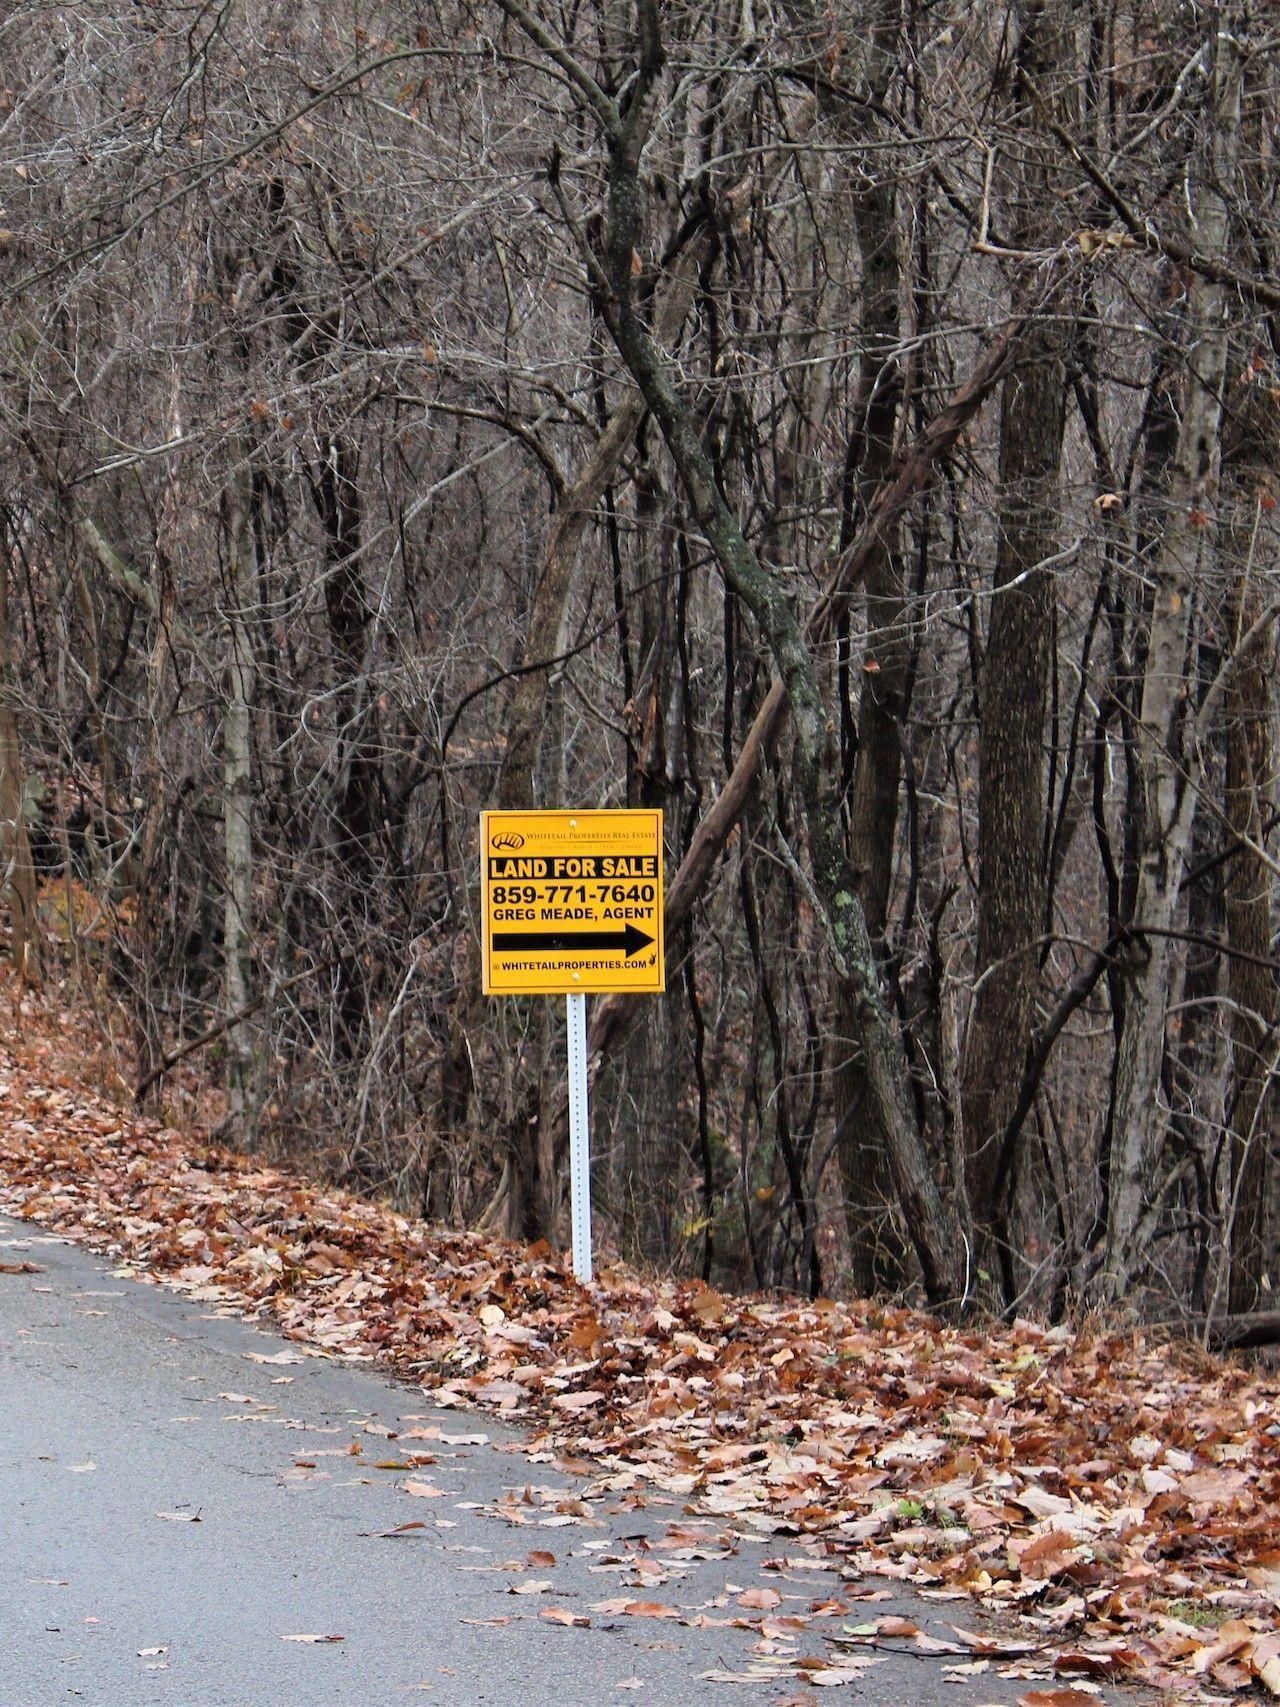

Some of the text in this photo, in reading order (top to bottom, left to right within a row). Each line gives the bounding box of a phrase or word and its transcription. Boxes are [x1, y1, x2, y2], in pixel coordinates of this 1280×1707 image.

[491, 857, 655, 878] LAND FOR SALE
[493, 885, 655, 904] 859-771-7640
[493, 907, 654, 921] GREG MEADE, AGENT
[502, 960, 647, 970] WHITETAILPROPERTIES.COM
